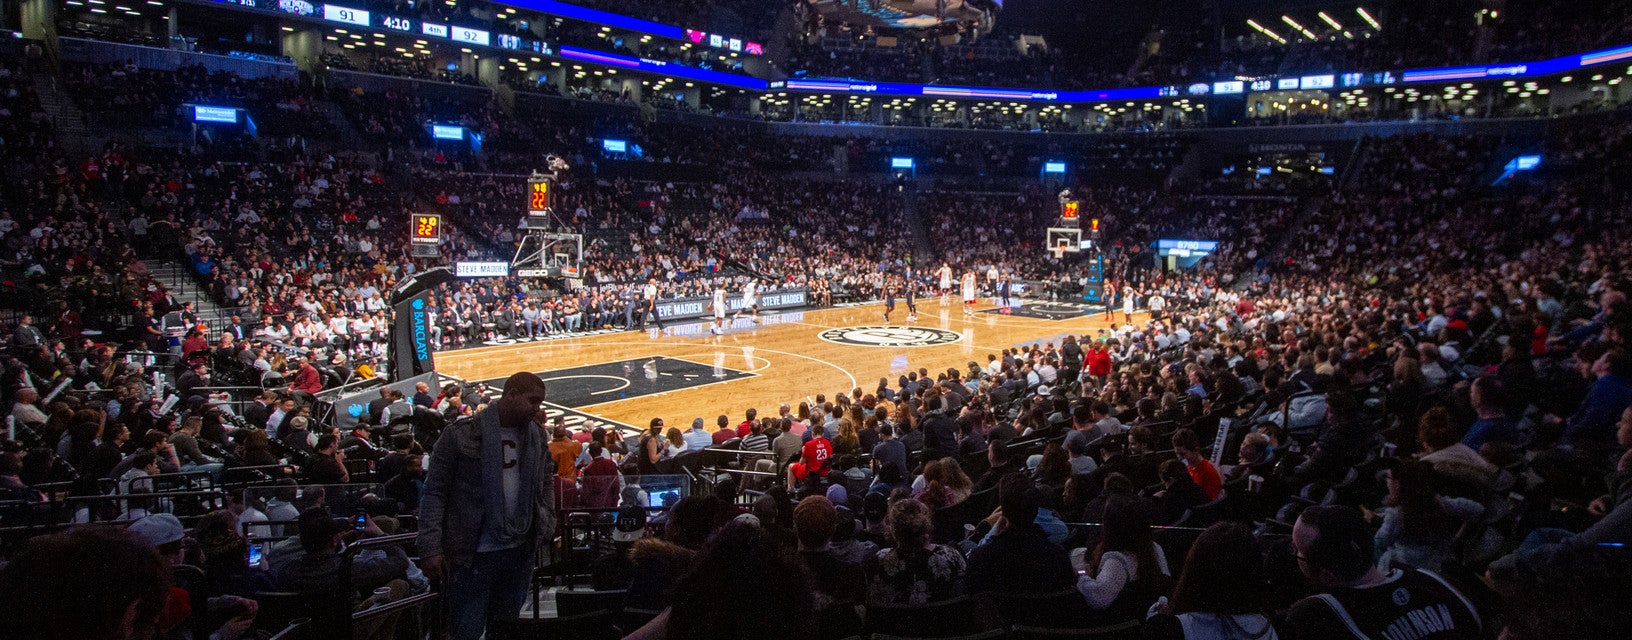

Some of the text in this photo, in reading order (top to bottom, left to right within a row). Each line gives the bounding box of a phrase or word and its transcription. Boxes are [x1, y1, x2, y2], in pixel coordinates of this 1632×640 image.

[340, 10, 355, 21] 91
[383, 16, 410, 31] 4:10
[428, 26, 442, 34] 4th
[463, 31, 478, 41] 92
[532, 192, 545, 209] 22
[418, 224, 433, 236] 22
[457, 265, 508, 273] STEVE MADDEN
[518, 269, 548, 277] GEICO
[762, 293, 804, 307] STEVE MADDEN
[674, 302, 703, 315] MADDEN
[413, 311, 428, 361] BARCLAYS
[816, 448, 827, 460] 23
